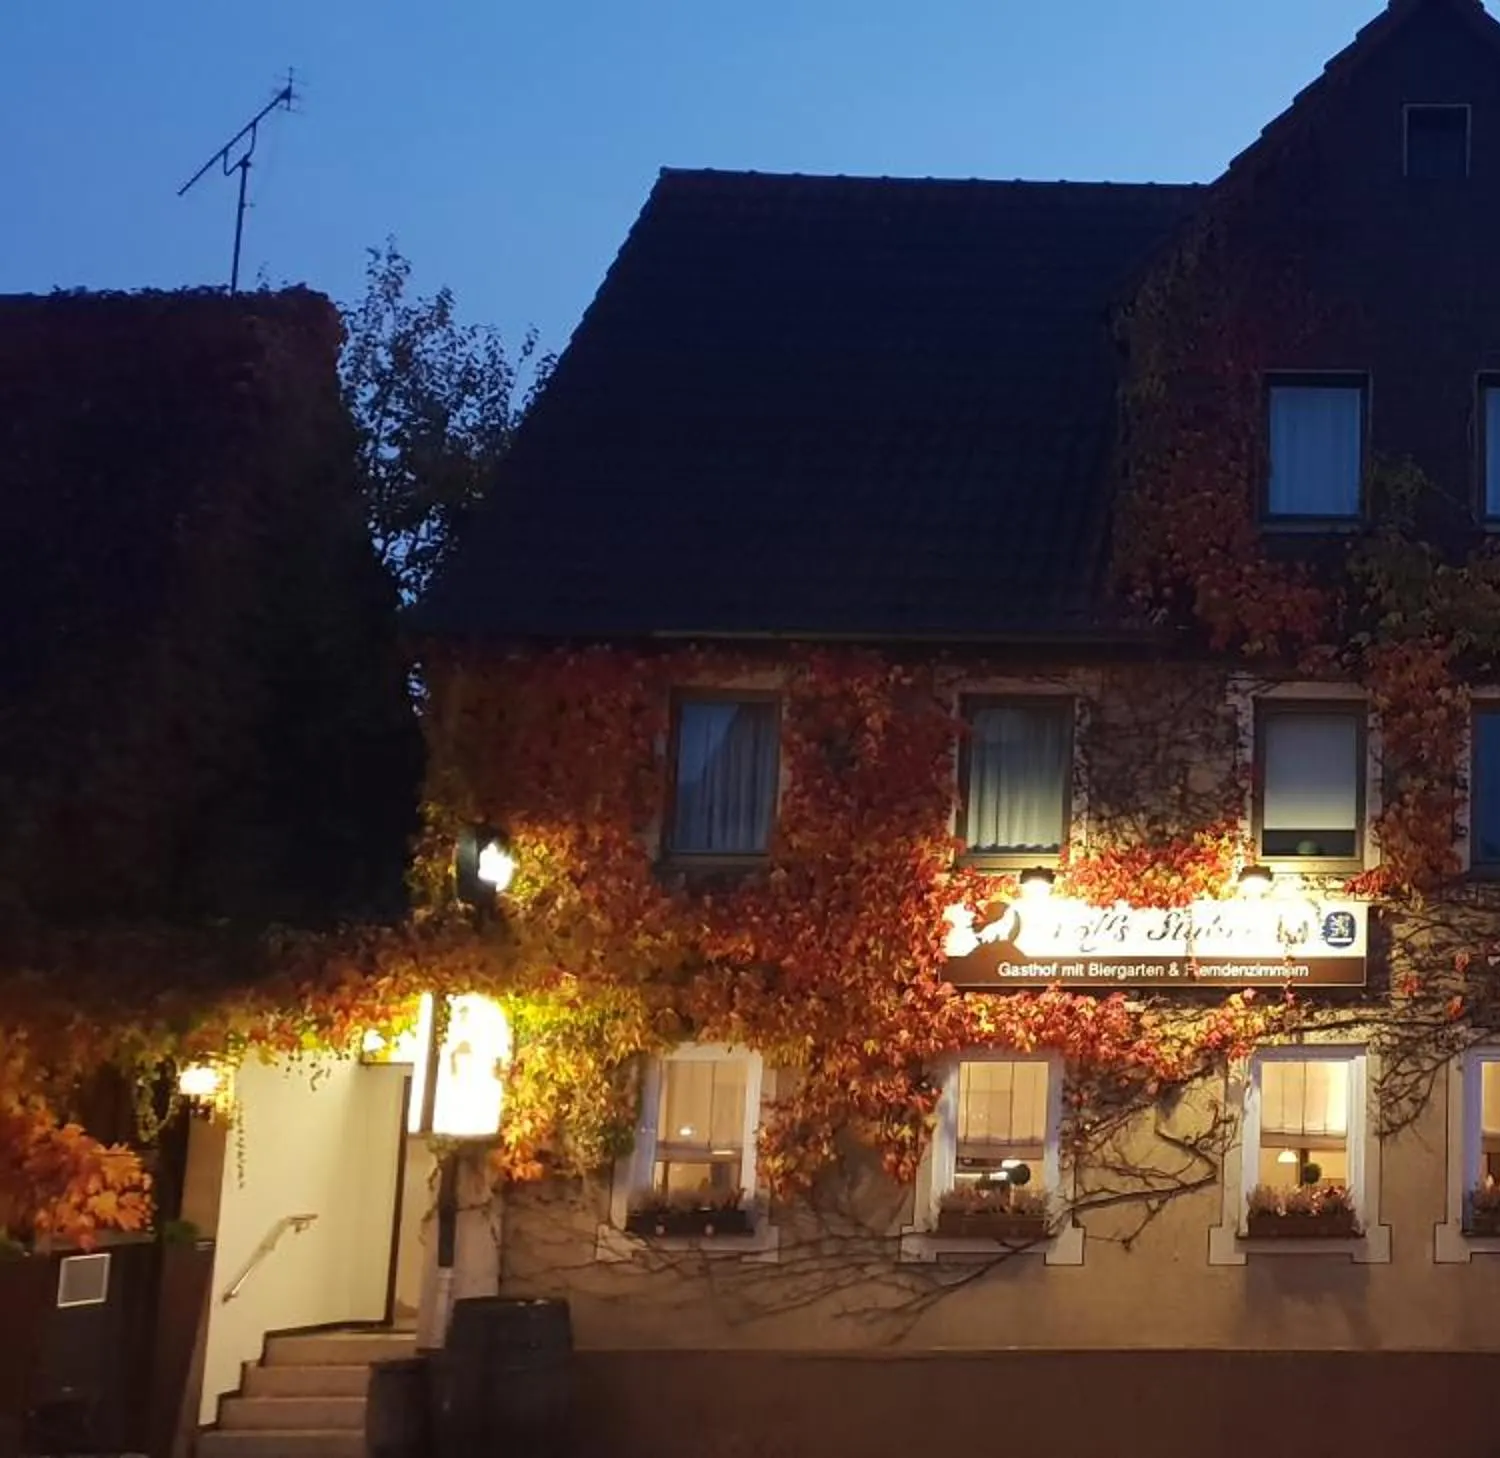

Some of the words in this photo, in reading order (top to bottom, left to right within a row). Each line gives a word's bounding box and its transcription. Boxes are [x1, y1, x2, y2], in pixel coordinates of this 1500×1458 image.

[998, 962, 1057, 978] Gasthof
[1062, 962, 1085, 977] mit
[1089, 962, 1164, 980] Biergarten
[1168, 962, 1180, 977] &
